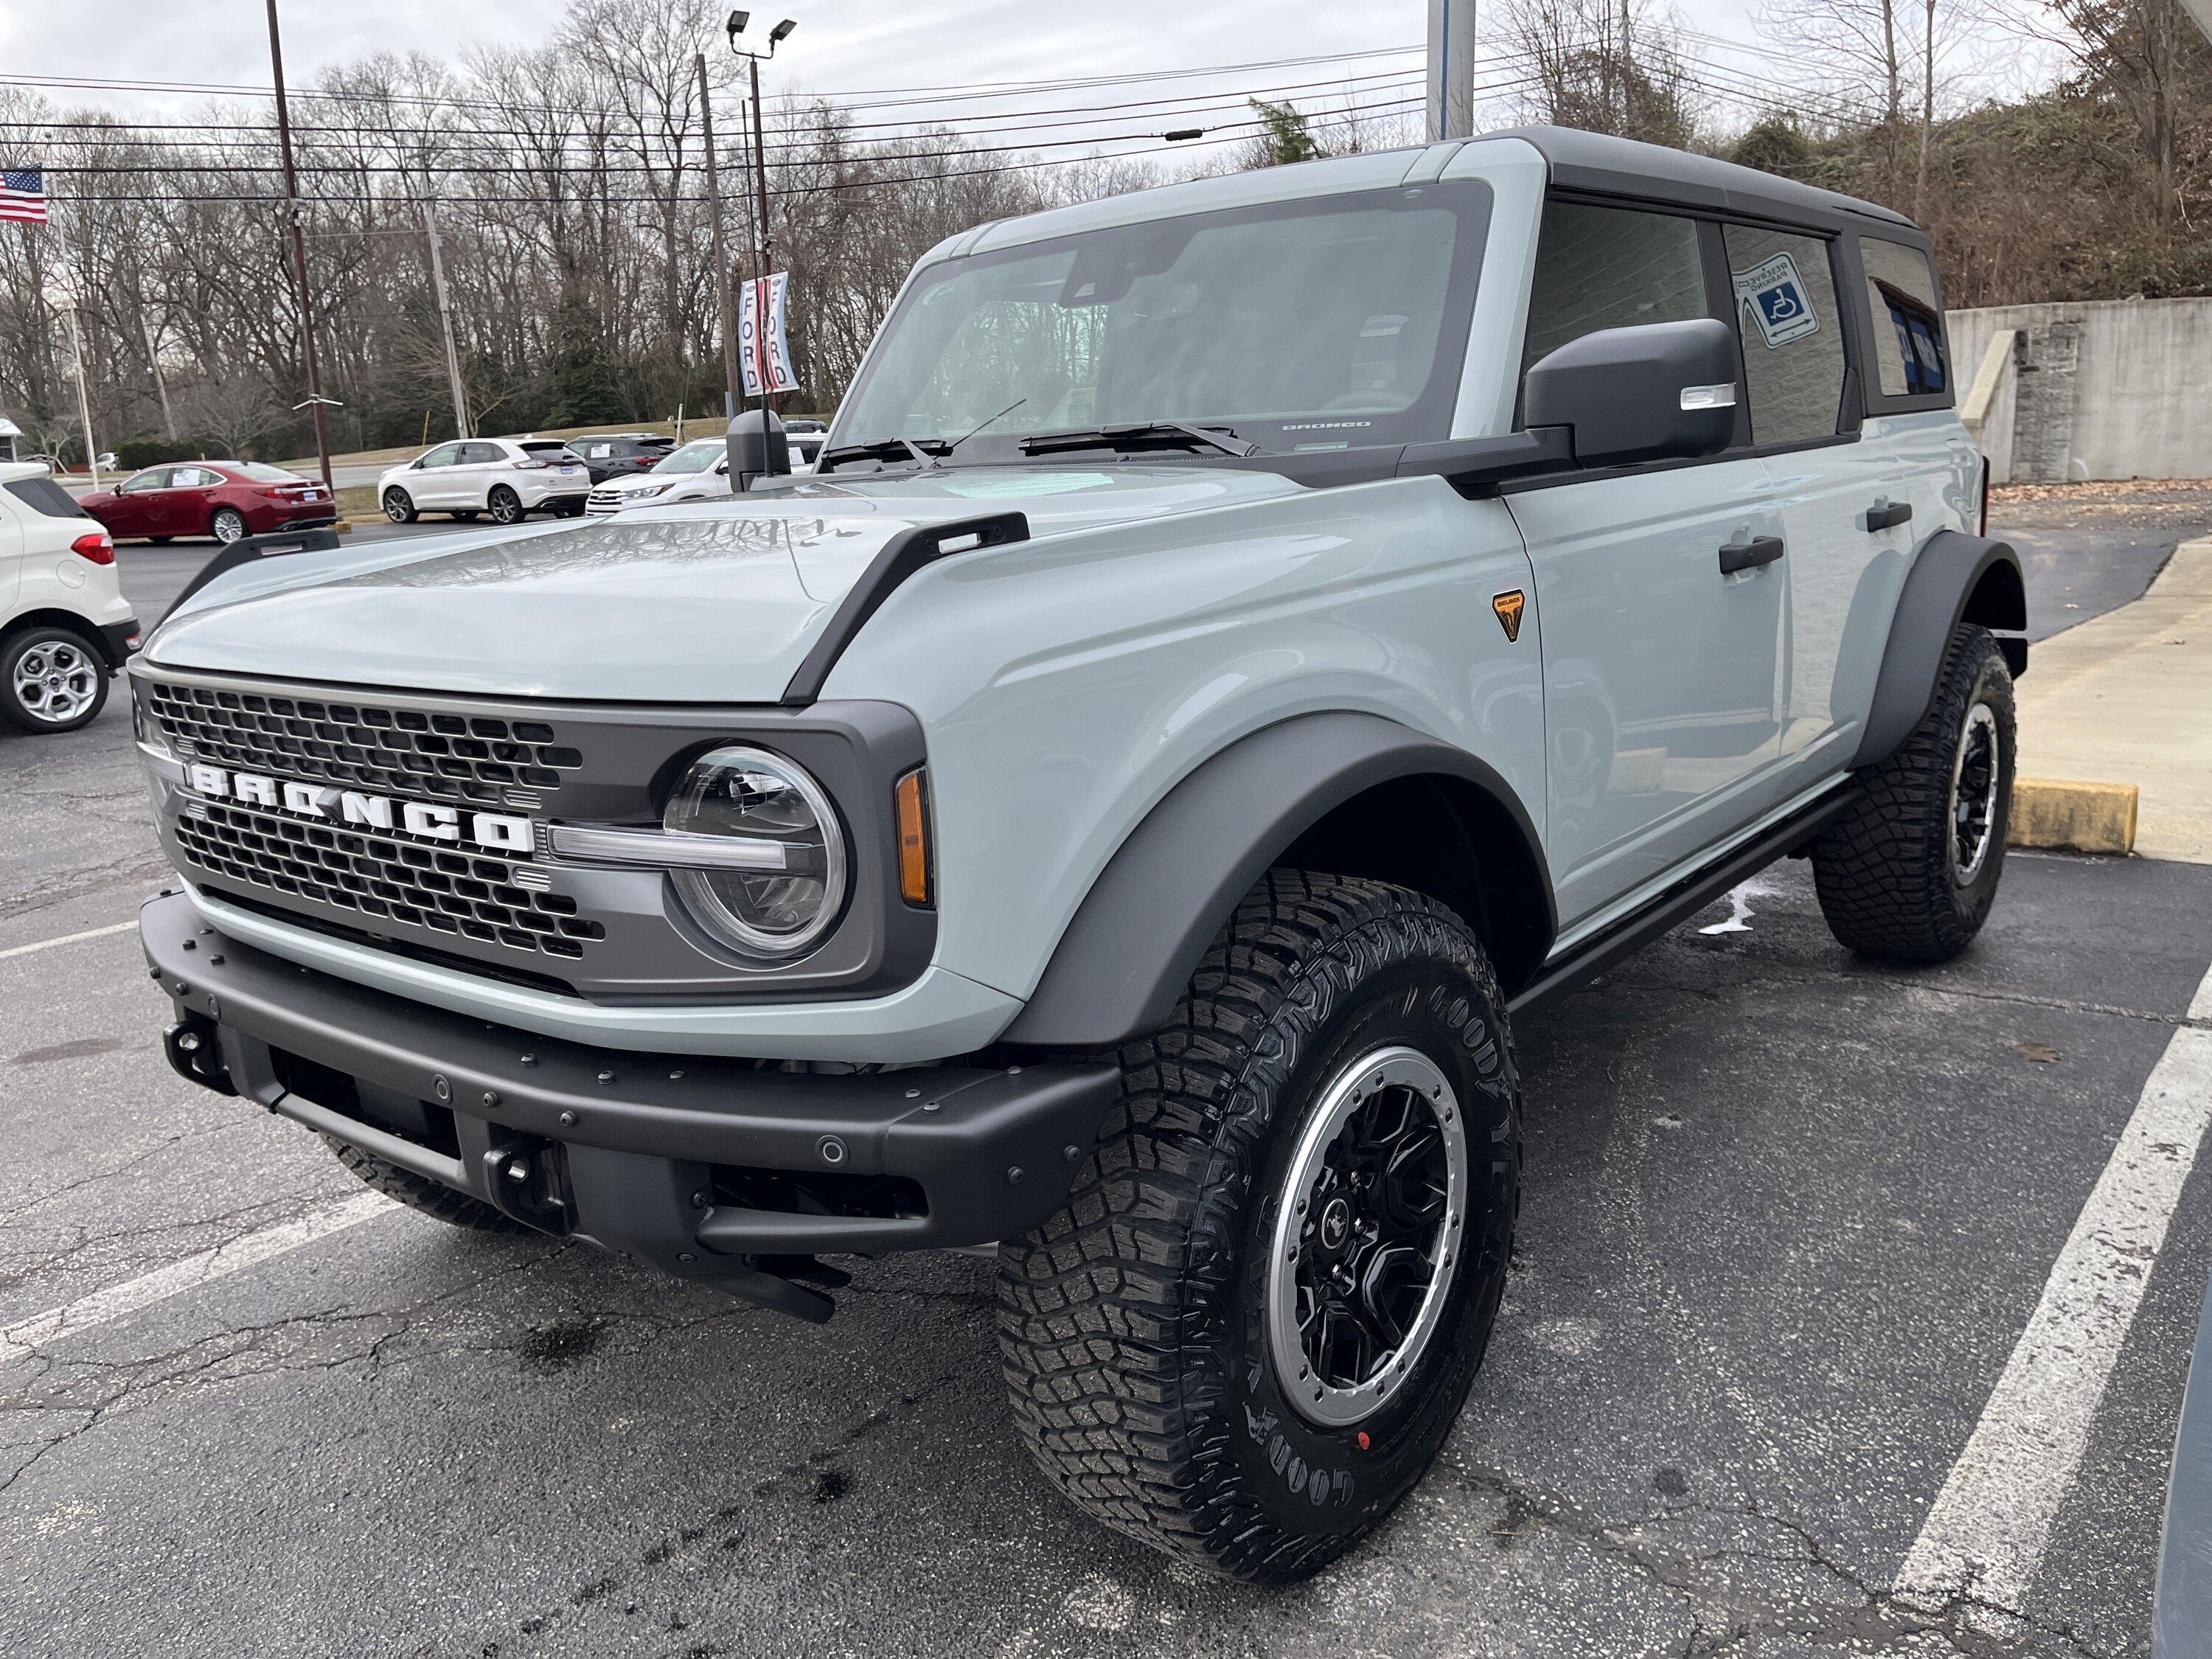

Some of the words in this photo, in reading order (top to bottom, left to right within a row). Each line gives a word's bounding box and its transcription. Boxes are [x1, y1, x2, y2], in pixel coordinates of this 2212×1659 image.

[742, 297, 757, 389] FORD
[1282, 421, 1371, 431] BRONCO
[190, 762, 536, 853] BRONCO
